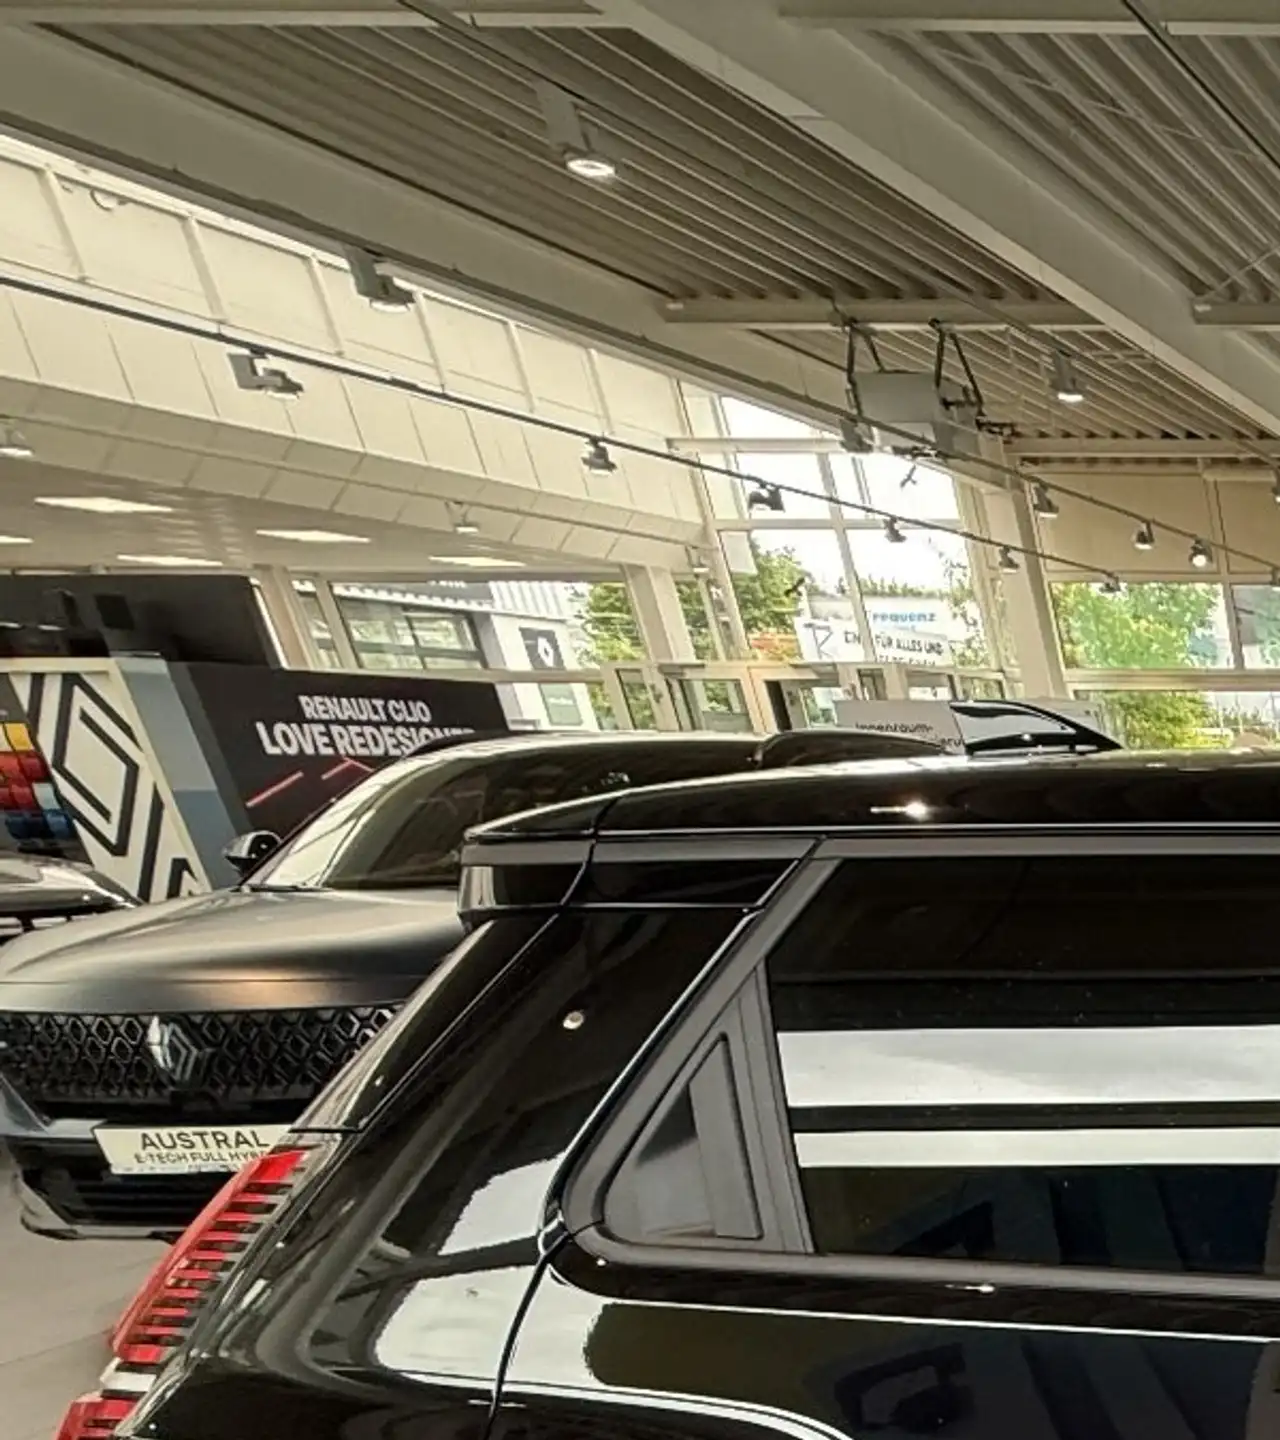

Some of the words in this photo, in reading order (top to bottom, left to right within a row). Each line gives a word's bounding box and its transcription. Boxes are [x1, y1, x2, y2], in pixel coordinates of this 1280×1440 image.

[298, 695, 388, 722] RENAULT
[388, 699, 433, 722] CLIO
[255, 721, 330, 756] LOVE
[329, 722, 475, 757] REDESI
[141, 1130, 270, 1151] AUSTRAL
[134, 1153, 189, 1164] E-TECH
[191, 1152, 228, 1163] FULL
